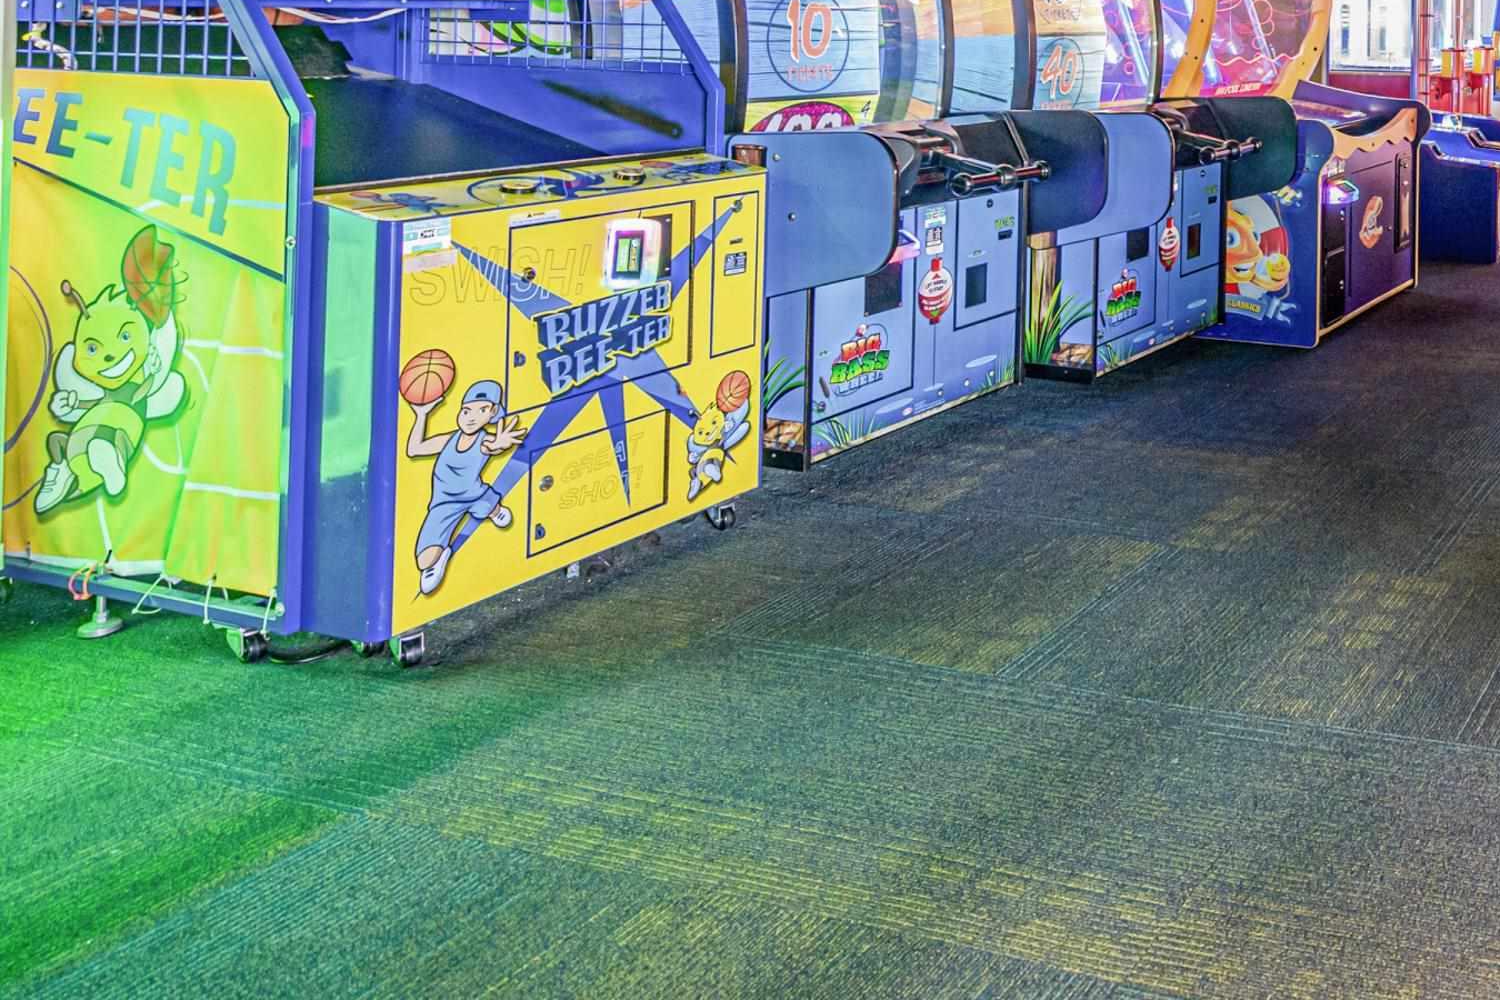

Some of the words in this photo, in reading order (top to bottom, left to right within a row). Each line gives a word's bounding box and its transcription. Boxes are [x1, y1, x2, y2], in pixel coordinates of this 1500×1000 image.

[1040, 43, 1077, 100] 40
[409, 242, 592, 305] SWISH!
[540, 282, 671, 350] BUZZER
[543, 315, 671, 394] BEE-TER
[830, 350, 890, 384] BASS
[840, 333, 882, 362] BIG
